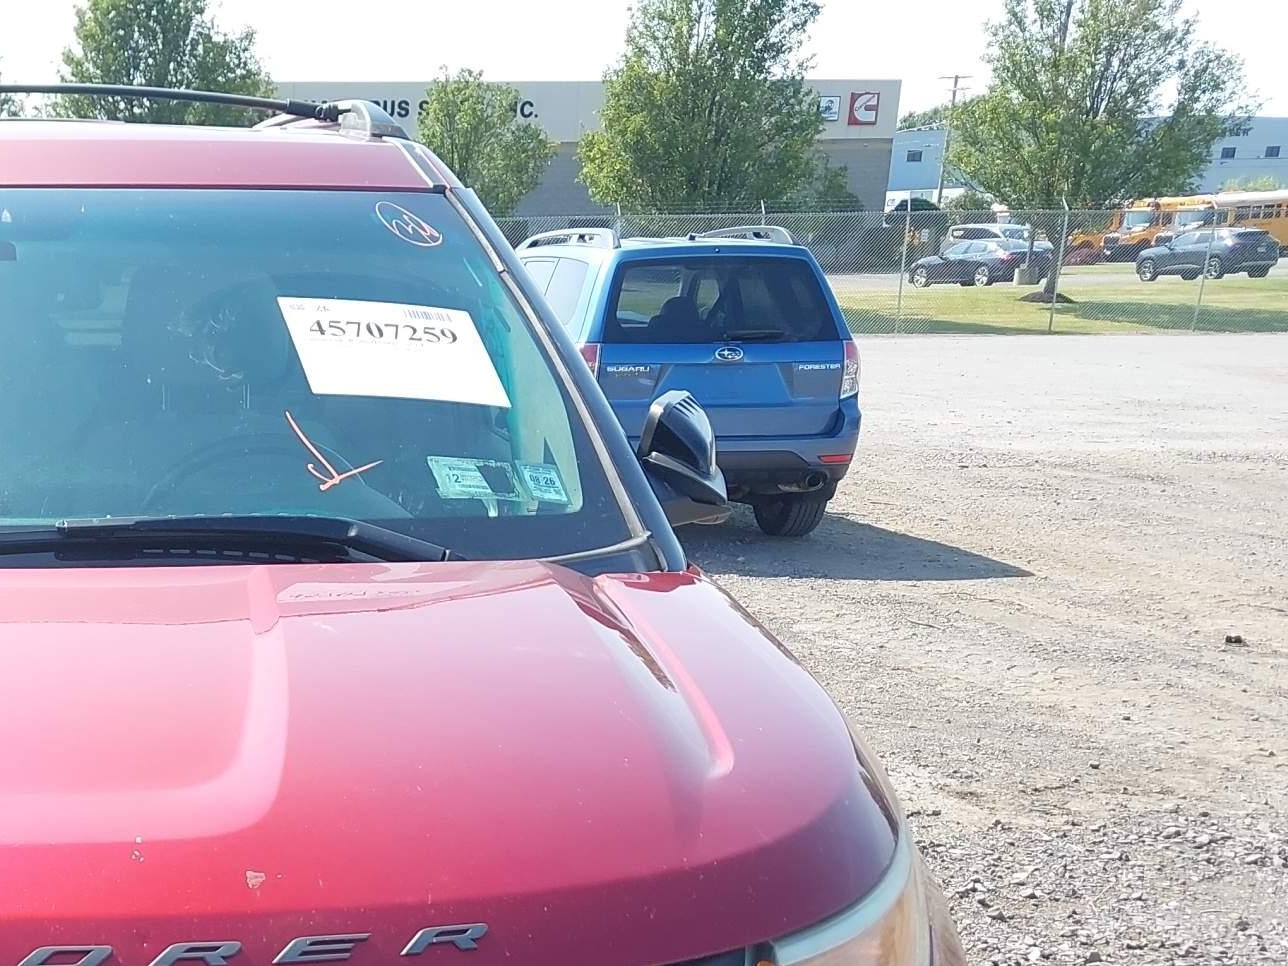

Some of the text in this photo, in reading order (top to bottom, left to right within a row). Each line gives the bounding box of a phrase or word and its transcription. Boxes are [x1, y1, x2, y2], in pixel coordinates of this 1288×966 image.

[371, 100, 410, 118] US
[309, 319, 458, 344] 45707259
[798, 363, 841, 371] FORESTER
